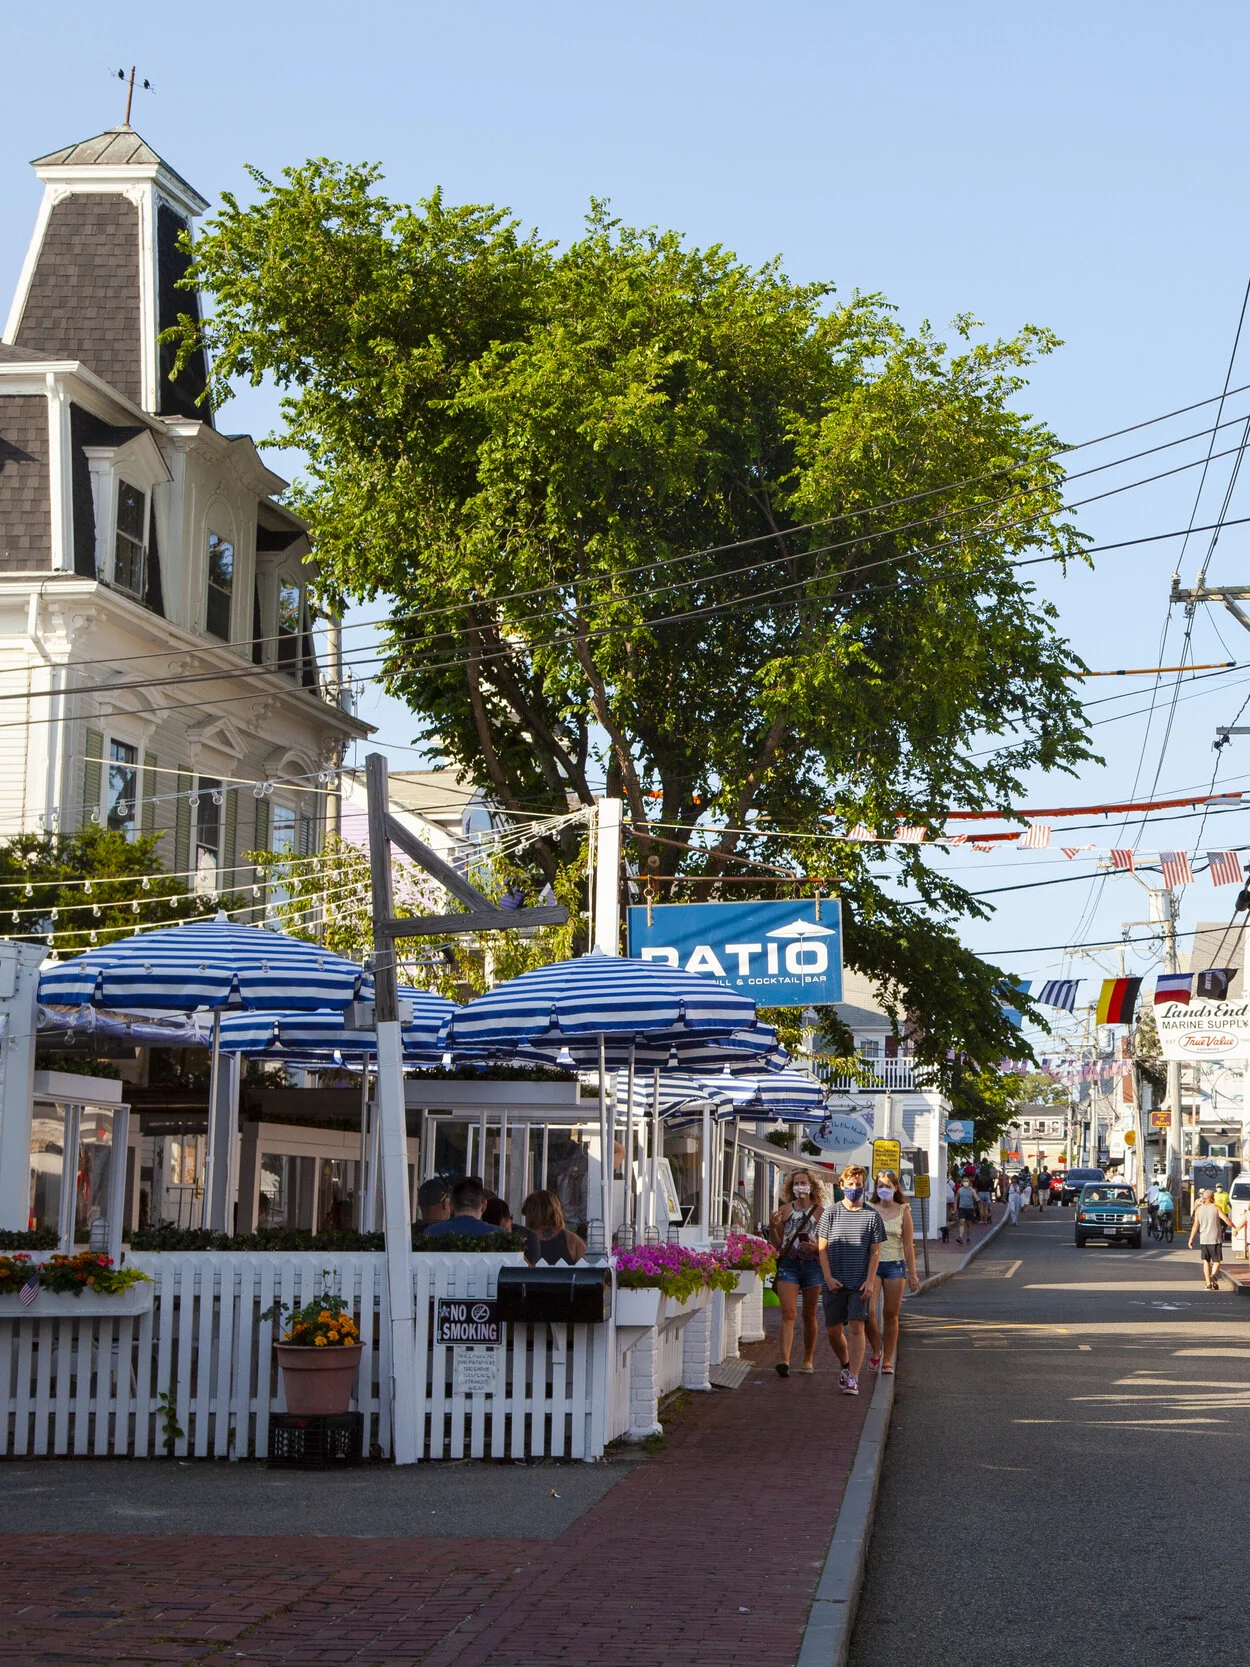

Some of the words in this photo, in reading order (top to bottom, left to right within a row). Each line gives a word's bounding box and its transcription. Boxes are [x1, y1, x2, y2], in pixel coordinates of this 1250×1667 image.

[1214, 1003, 1248, 1017] End
[1162, 1021, 1204, 1029] MARINE
[1208, 1020, 1248, 1028] SUPPLY
[1184, 1037, 1205, 1046] True
[1202, 1036, 1234, 1046] Value
[451, 1304, 466, 1321] NO
[443, 1323, 496, 1340] SMOKING
